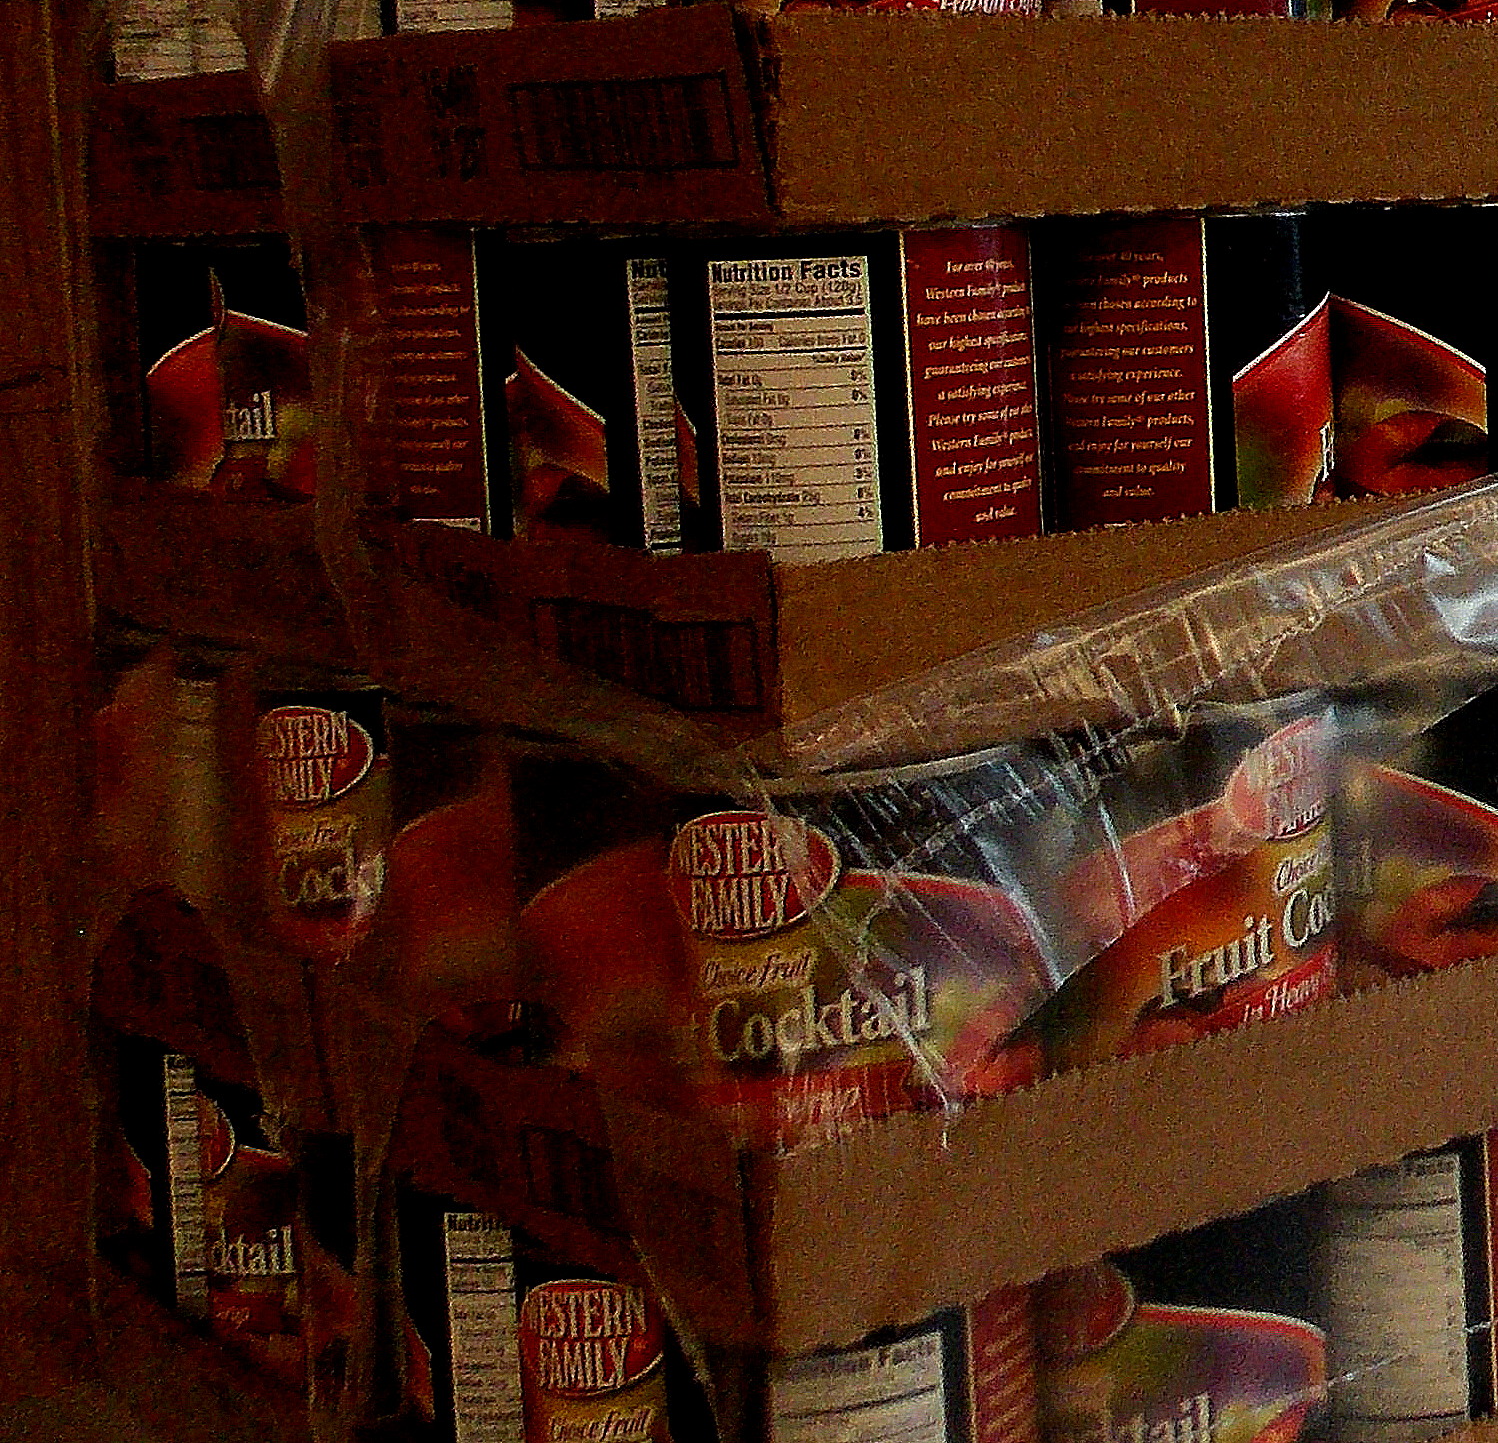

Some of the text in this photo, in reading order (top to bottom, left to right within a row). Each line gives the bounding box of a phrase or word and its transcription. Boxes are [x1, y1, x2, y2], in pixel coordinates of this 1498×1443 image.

[711, 261, 863, 283] Nutrition Facts
[689, 874, 789, 933] FAMILY
[1161, 914, 1274, 1008] Fruit
[711, 967, 928, 1061] Cocktail
[536, 1338, 630, 1388] FAMILY
